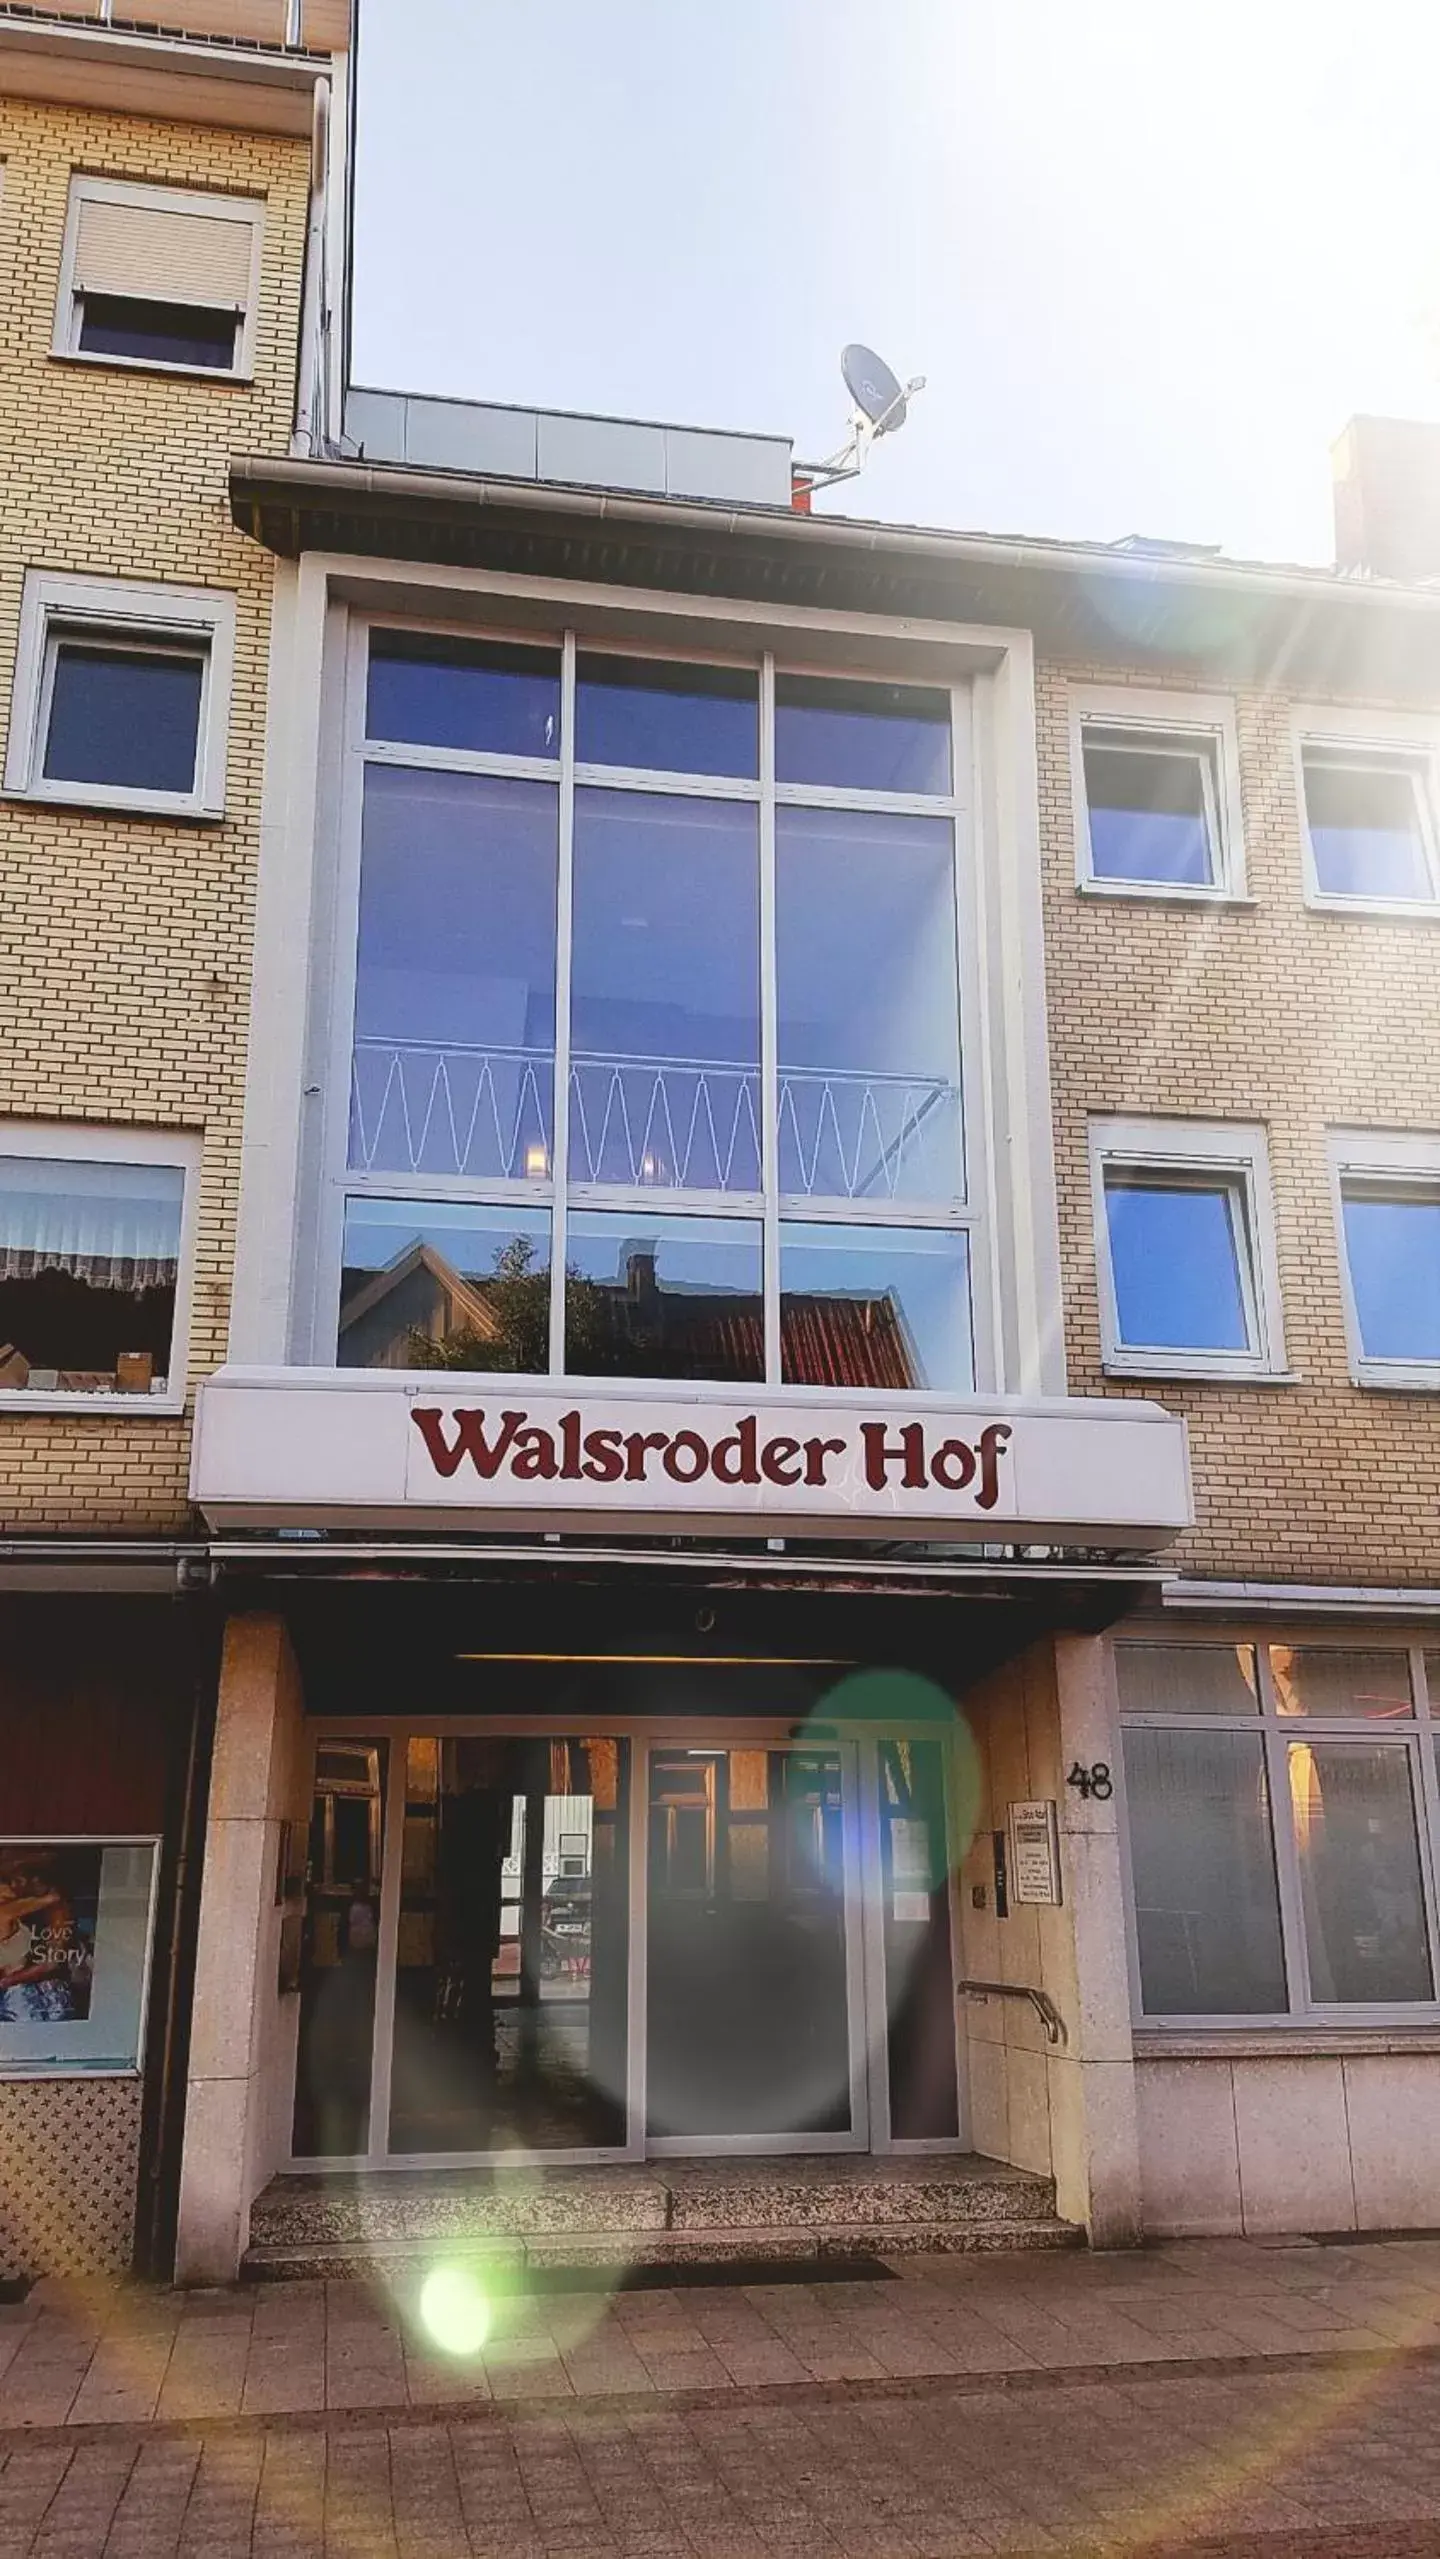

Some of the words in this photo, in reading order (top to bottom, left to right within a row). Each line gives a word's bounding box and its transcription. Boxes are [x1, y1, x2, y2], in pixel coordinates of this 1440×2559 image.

[411, 1409, 847, 1486] Walsroder
[861, 1422, 1012, 1509] Hof
[1066, 1762, 1112, 1800] 48
[31, 1924, 73, 1941] Love
[33, 1945, 86, 1966] Story
